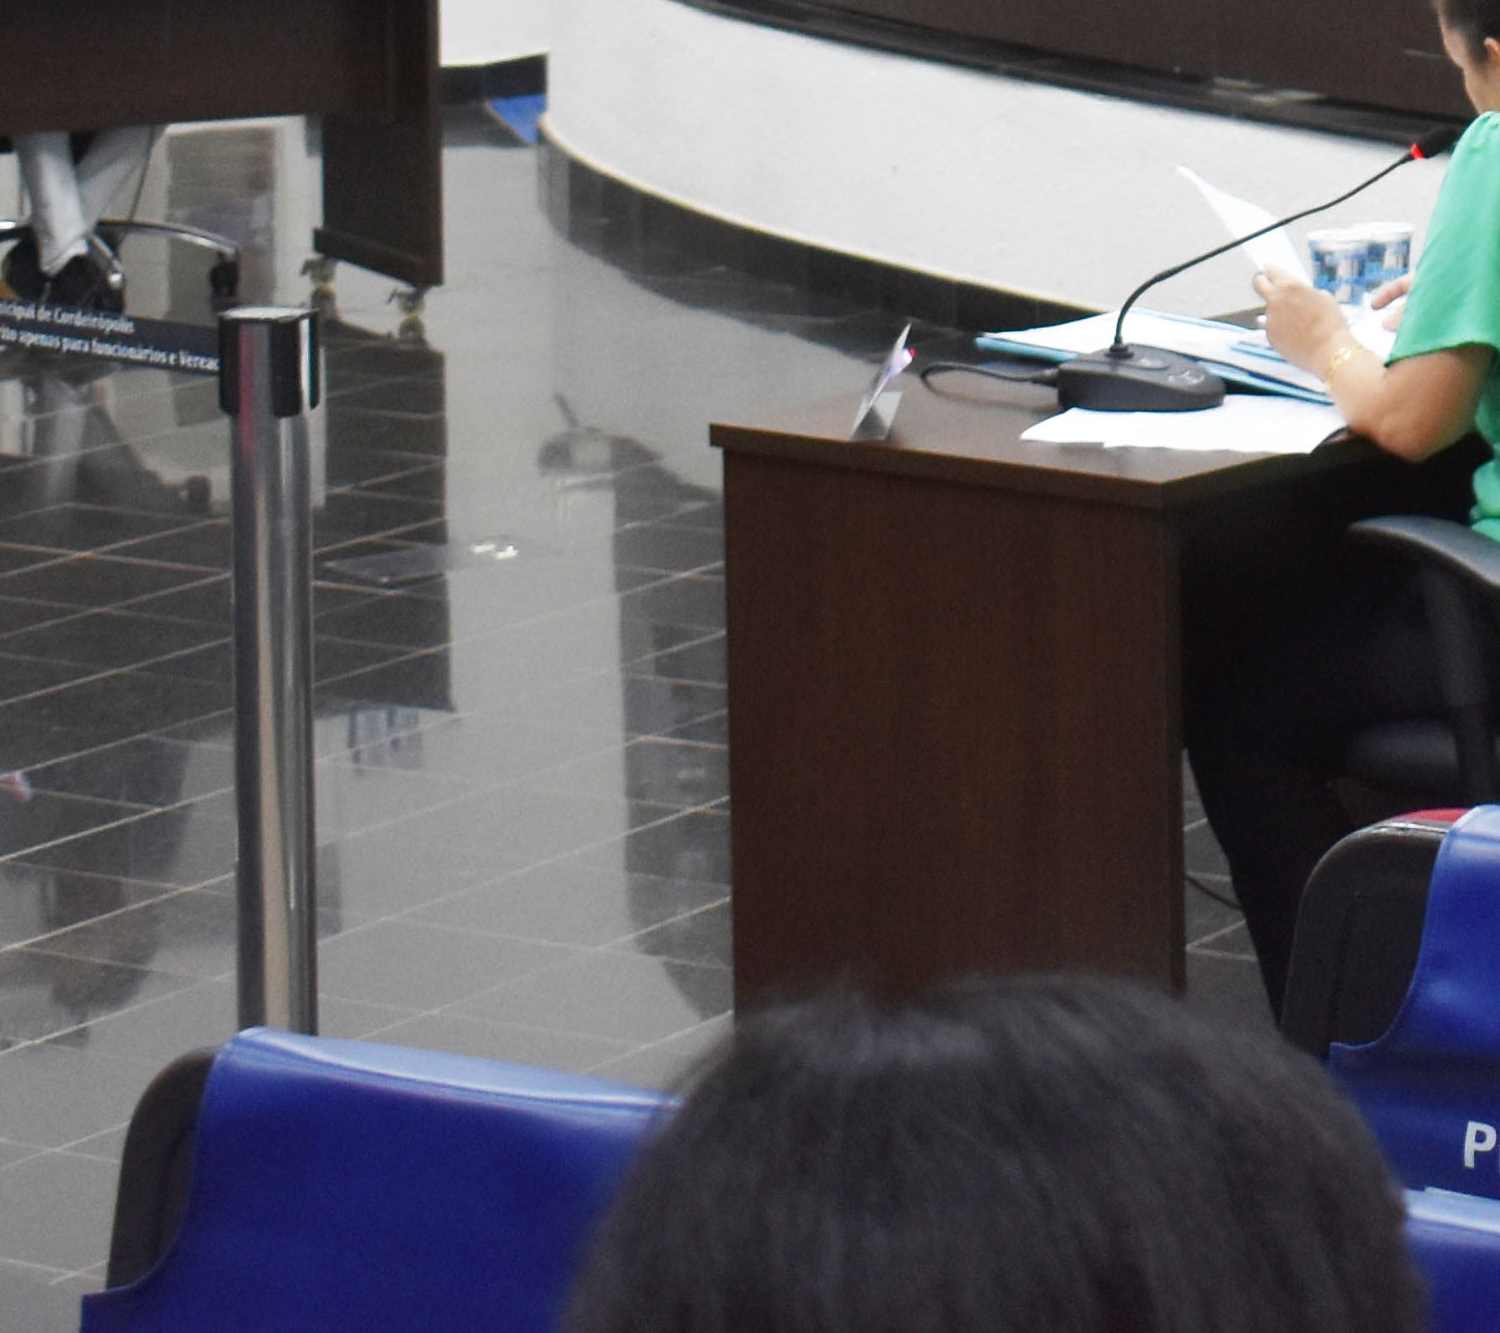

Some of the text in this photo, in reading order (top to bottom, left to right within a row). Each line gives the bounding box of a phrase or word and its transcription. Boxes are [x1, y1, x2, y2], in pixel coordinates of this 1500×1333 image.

[37, 304, 51, 322] de
[54, 306, 136, 334] Cordeirópolis
[18, 329, 61, 349] apenas
[62, 335, 90, 355] para
[91, 336, 167, 363] funcionários
